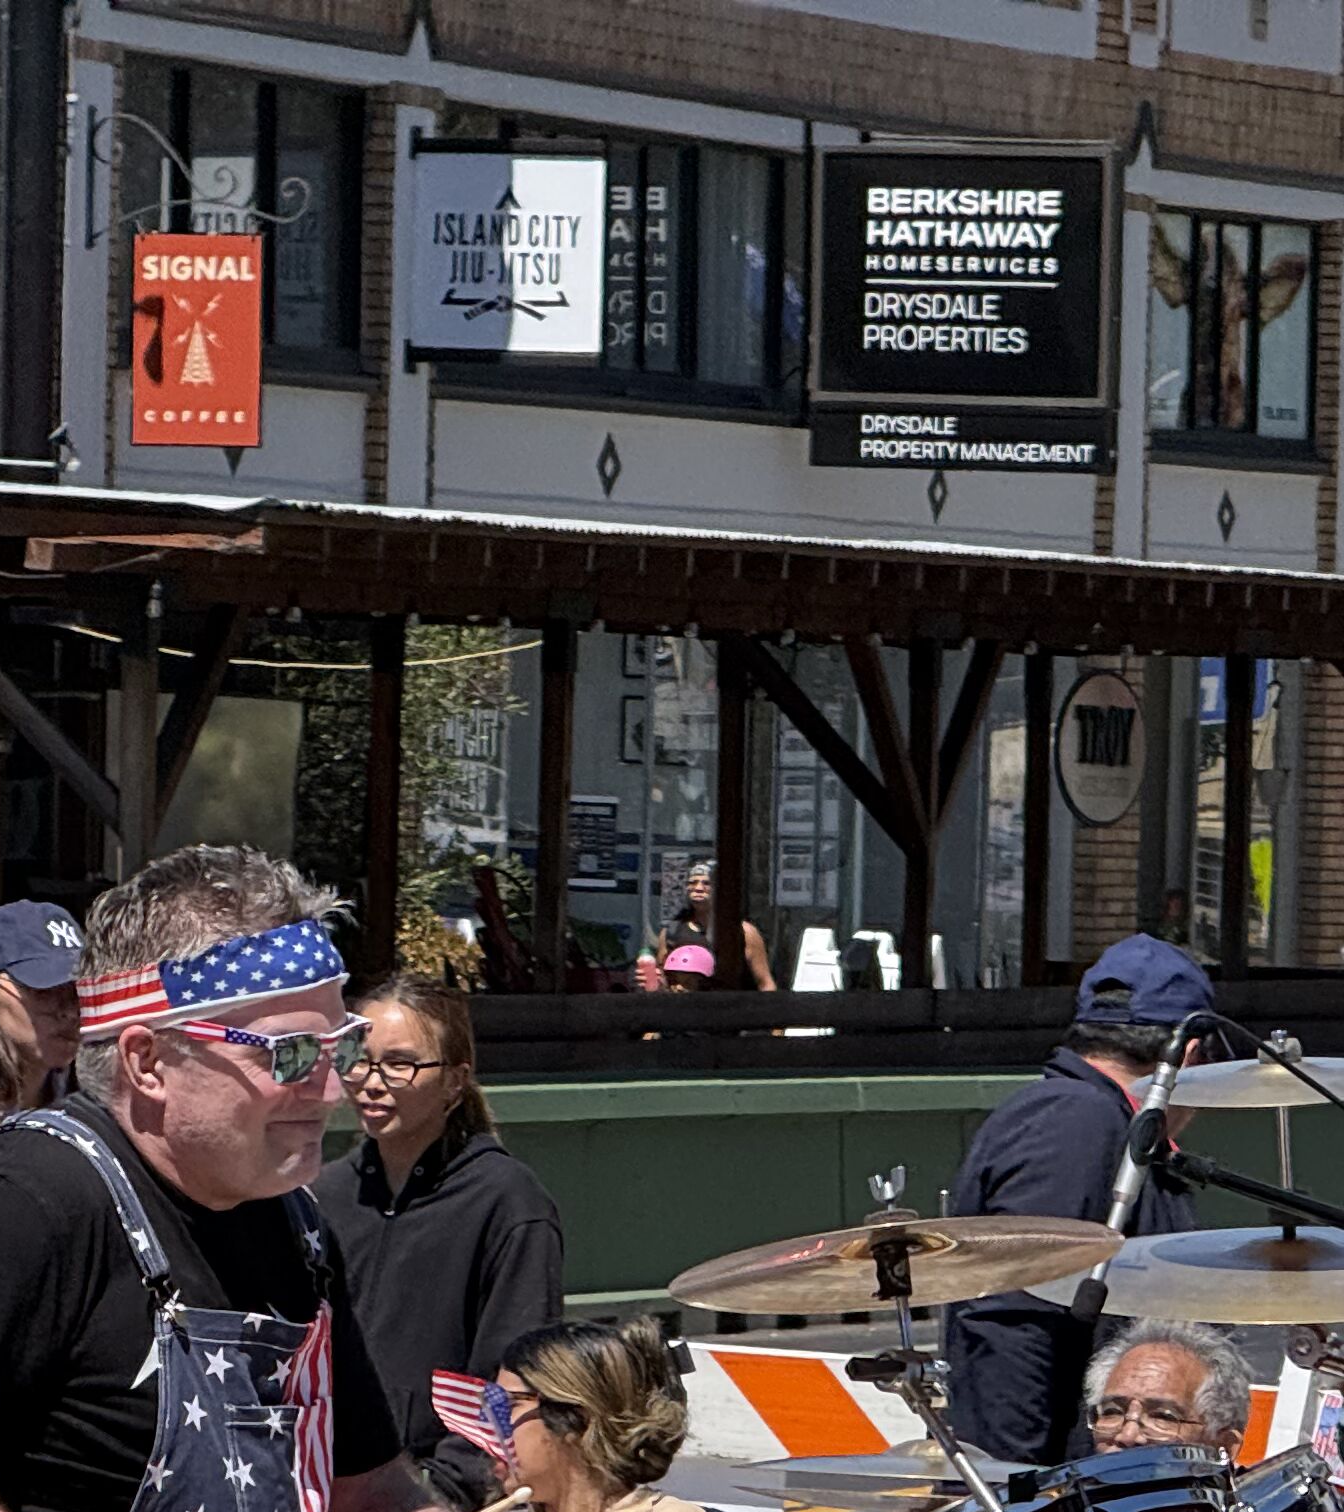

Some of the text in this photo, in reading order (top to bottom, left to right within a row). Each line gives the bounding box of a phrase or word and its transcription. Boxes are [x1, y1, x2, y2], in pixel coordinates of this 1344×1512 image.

[866, 187, 1063, 216] BERKSHIRE
[433, 212, 581, 248] ISLAND CITY
[865, 220, 1060, 248] HATHAWAY
[141, 255, 256, 282] SIGNAL
[449, 251, 562, 285] JIU-JITSU
[865, 254, 1059, 276] HOMESERVICES
[864, 293, 1001, 322] DRYSDALE
[863, 326, 1029, 354] PROPERTIES
[143, 408, 247, 424] COFFEE
[860, 415, 957, 435] DRYSDALE
[860, 440, 1096, 464] PROPERTY MANAGEMENT
